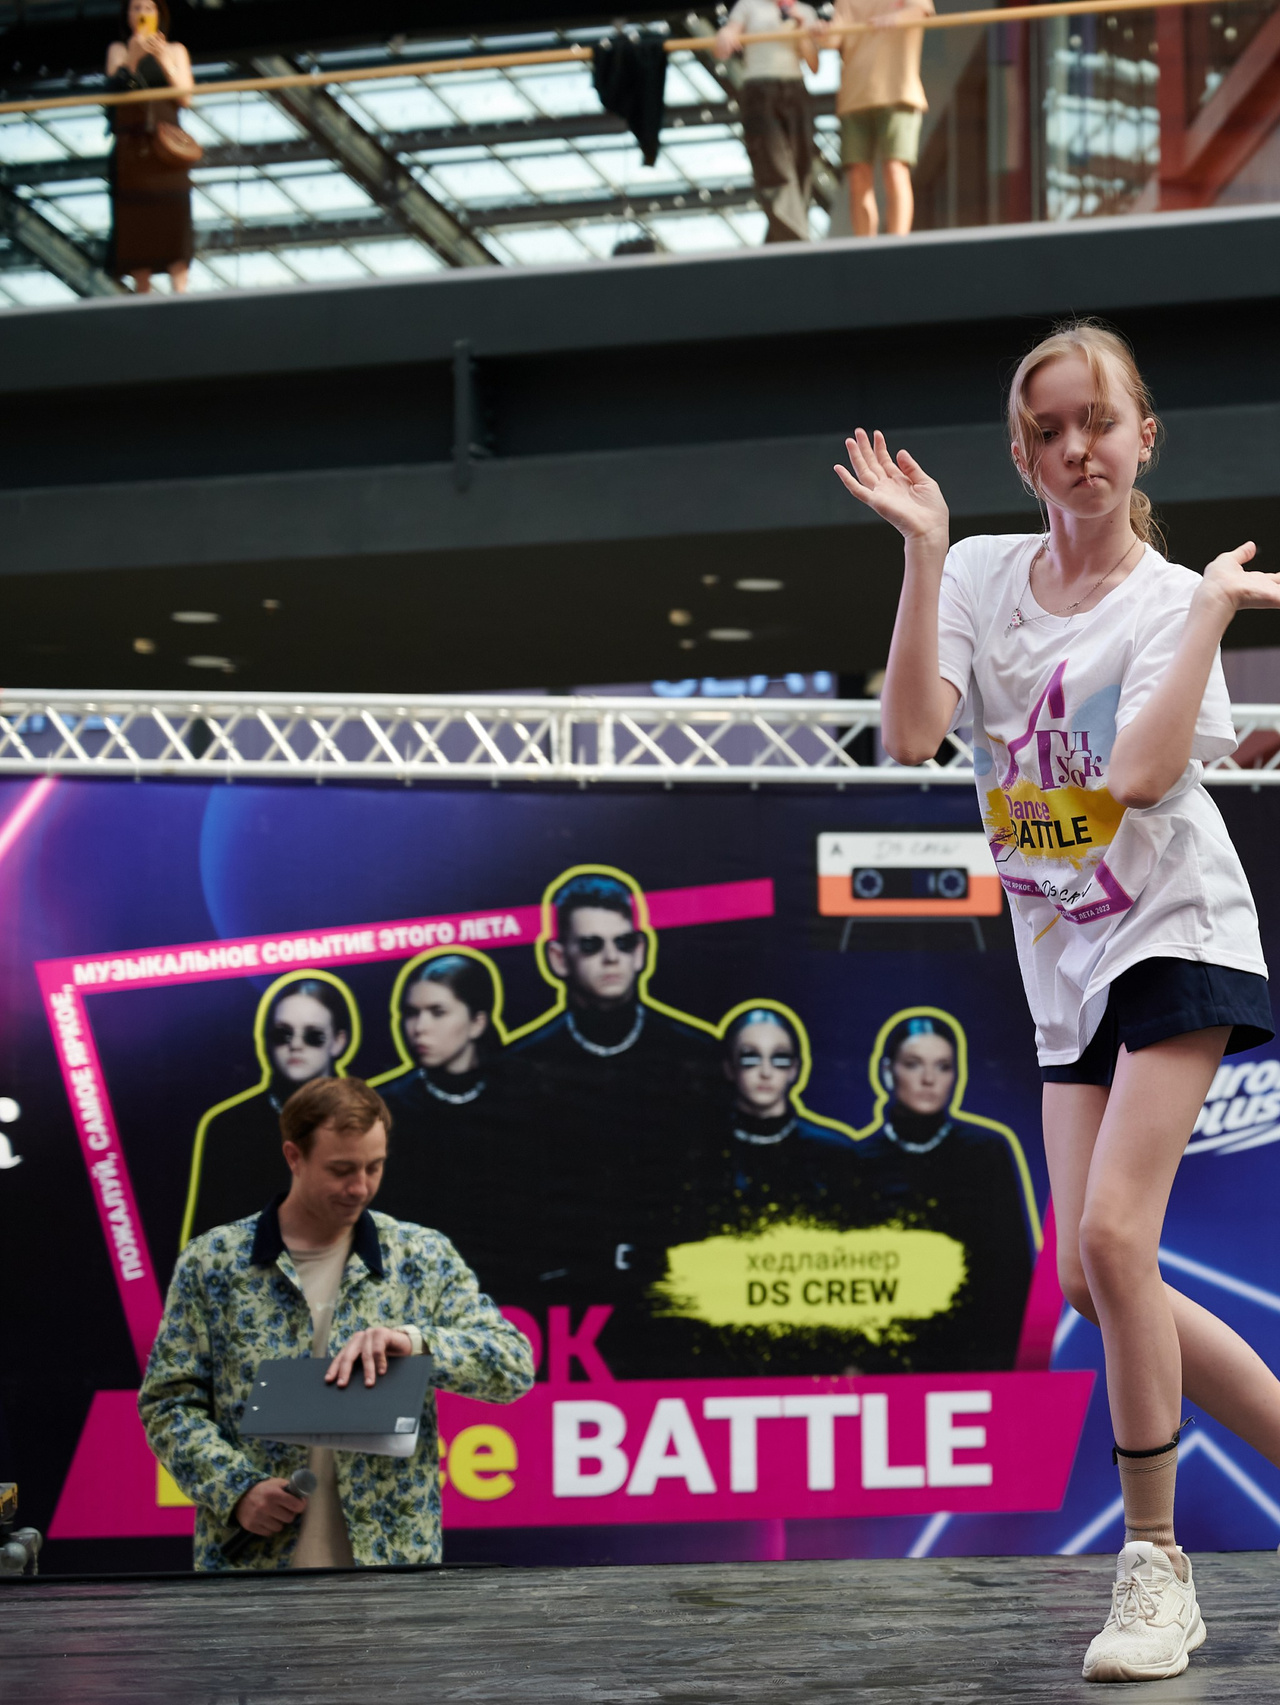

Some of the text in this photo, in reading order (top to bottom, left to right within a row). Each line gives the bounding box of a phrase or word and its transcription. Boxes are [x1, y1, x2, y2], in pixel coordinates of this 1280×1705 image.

[831, 842, 843, 857] A
[1078, 909, 1095, 920] ЛЕТА
[1095, 904, 1111, 915] 2023
[72, 915, 521, 985] МУЗЫКАЛЬНОЕ СОБЫТИЕ ЭТОГО ЛЕТА
[51, 984, 145, 1281] ПОЖАЛУЙ, САМОЕ ЯРКОЕ,
[746, 1247, 899, 1273] хедлайнер
[747, 1279, 898, 1306] DS CREW
[553, 1391, 993, 1498] BATTLE
